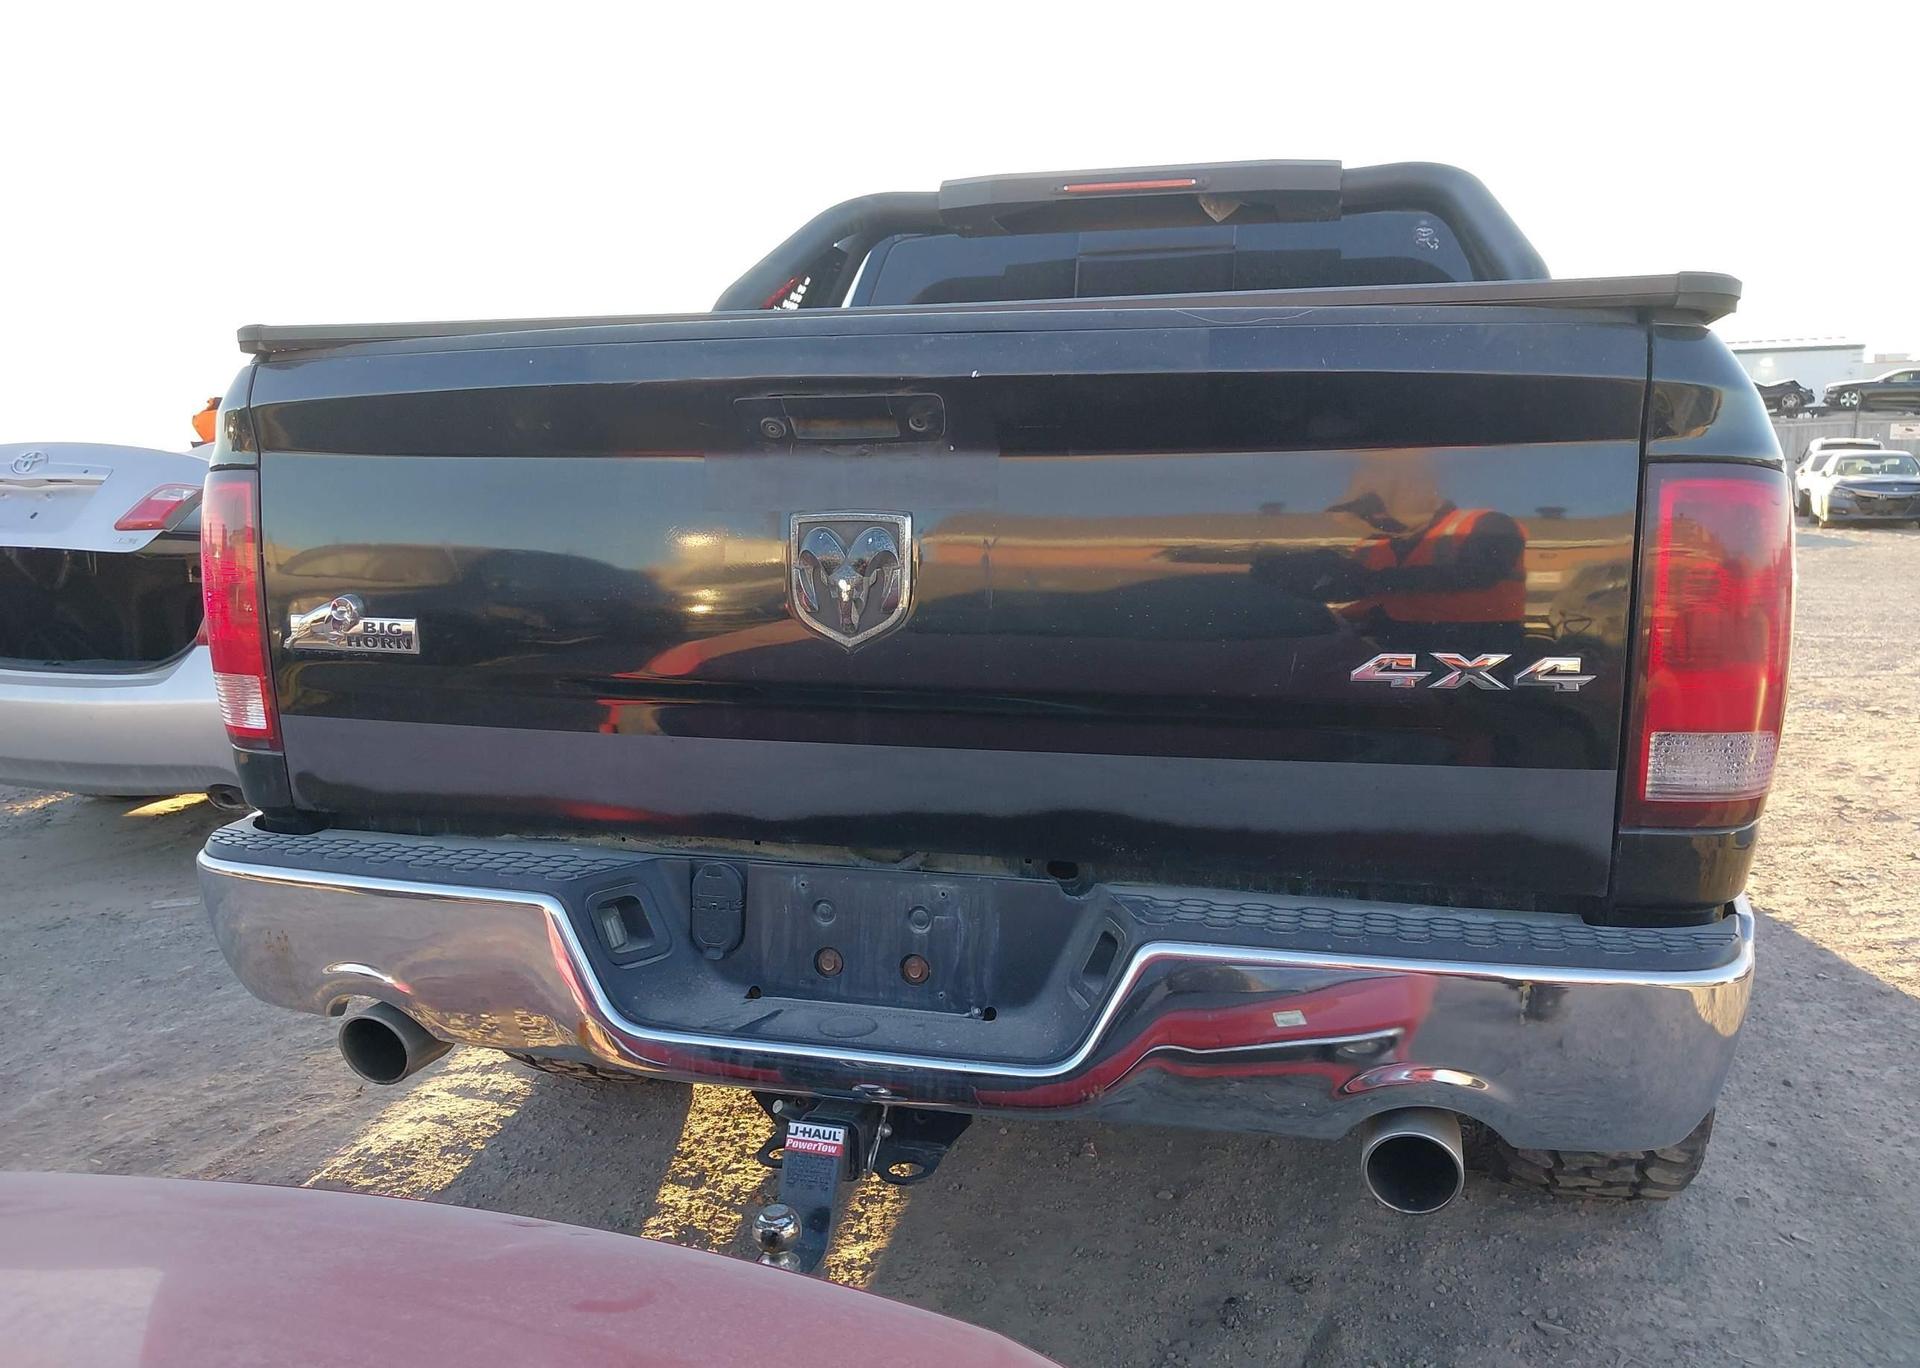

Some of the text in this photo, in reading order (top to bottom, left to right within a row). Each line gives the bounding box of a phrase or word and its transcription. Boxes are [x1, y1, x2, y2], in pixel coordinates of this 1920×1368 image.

[363, 621, 402, 635] BIG
[346, 635, 412, 650] HORN
[1351, 652, 1597, 692] 4X4
[785, 1138, 838, 1153] PowerTow
